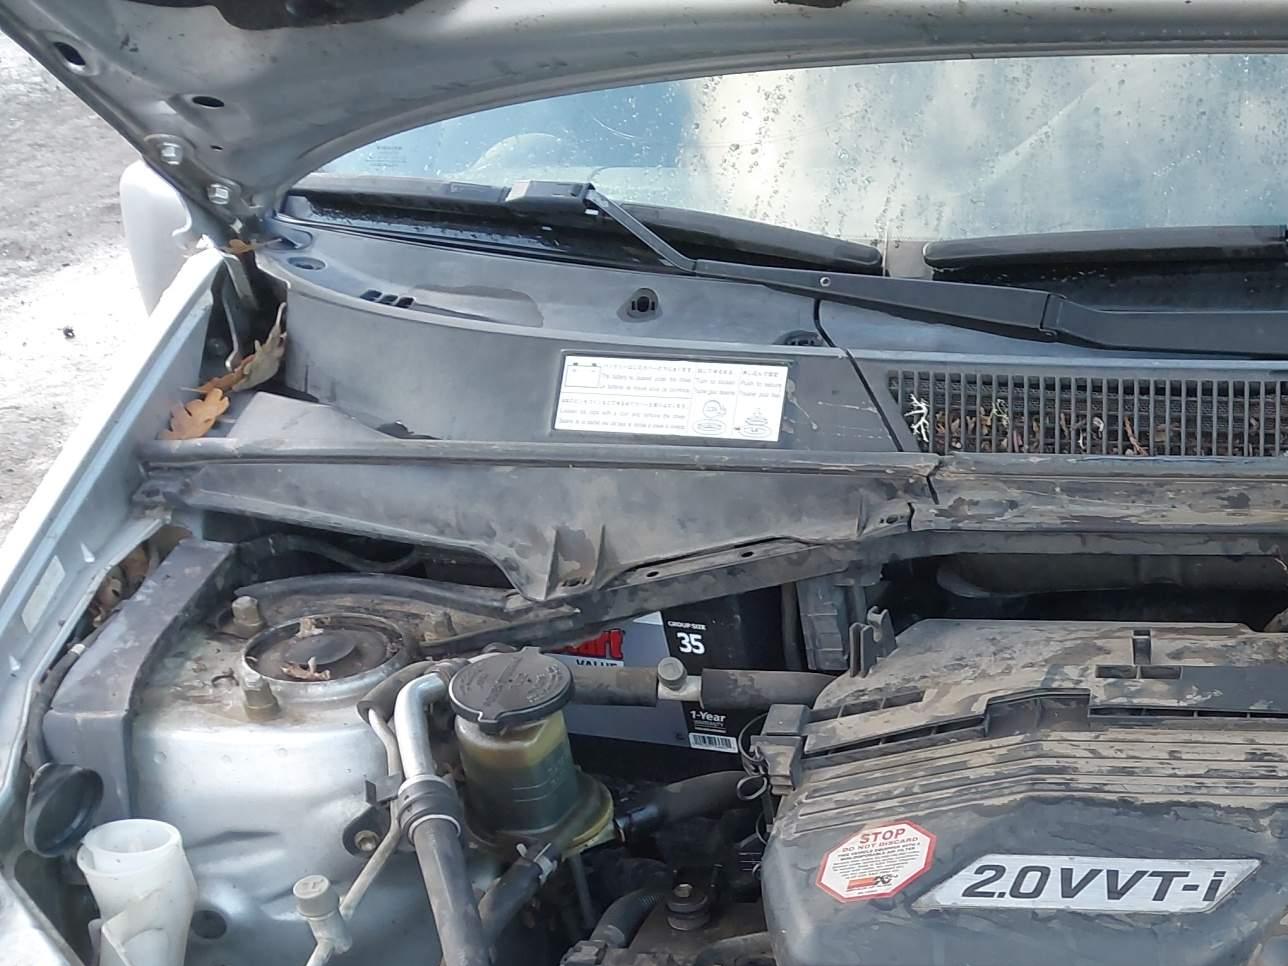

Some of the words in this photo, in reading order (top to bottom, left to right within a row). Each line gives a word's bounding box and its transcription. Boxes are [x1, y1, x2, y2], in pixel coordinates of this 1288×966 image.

[676, 632, 705, 655] 35
[689, 710, 726, 722] 1-Year
[860, 828, 905, 844] STOP
[879, 837, 918, 847] DISCARD
